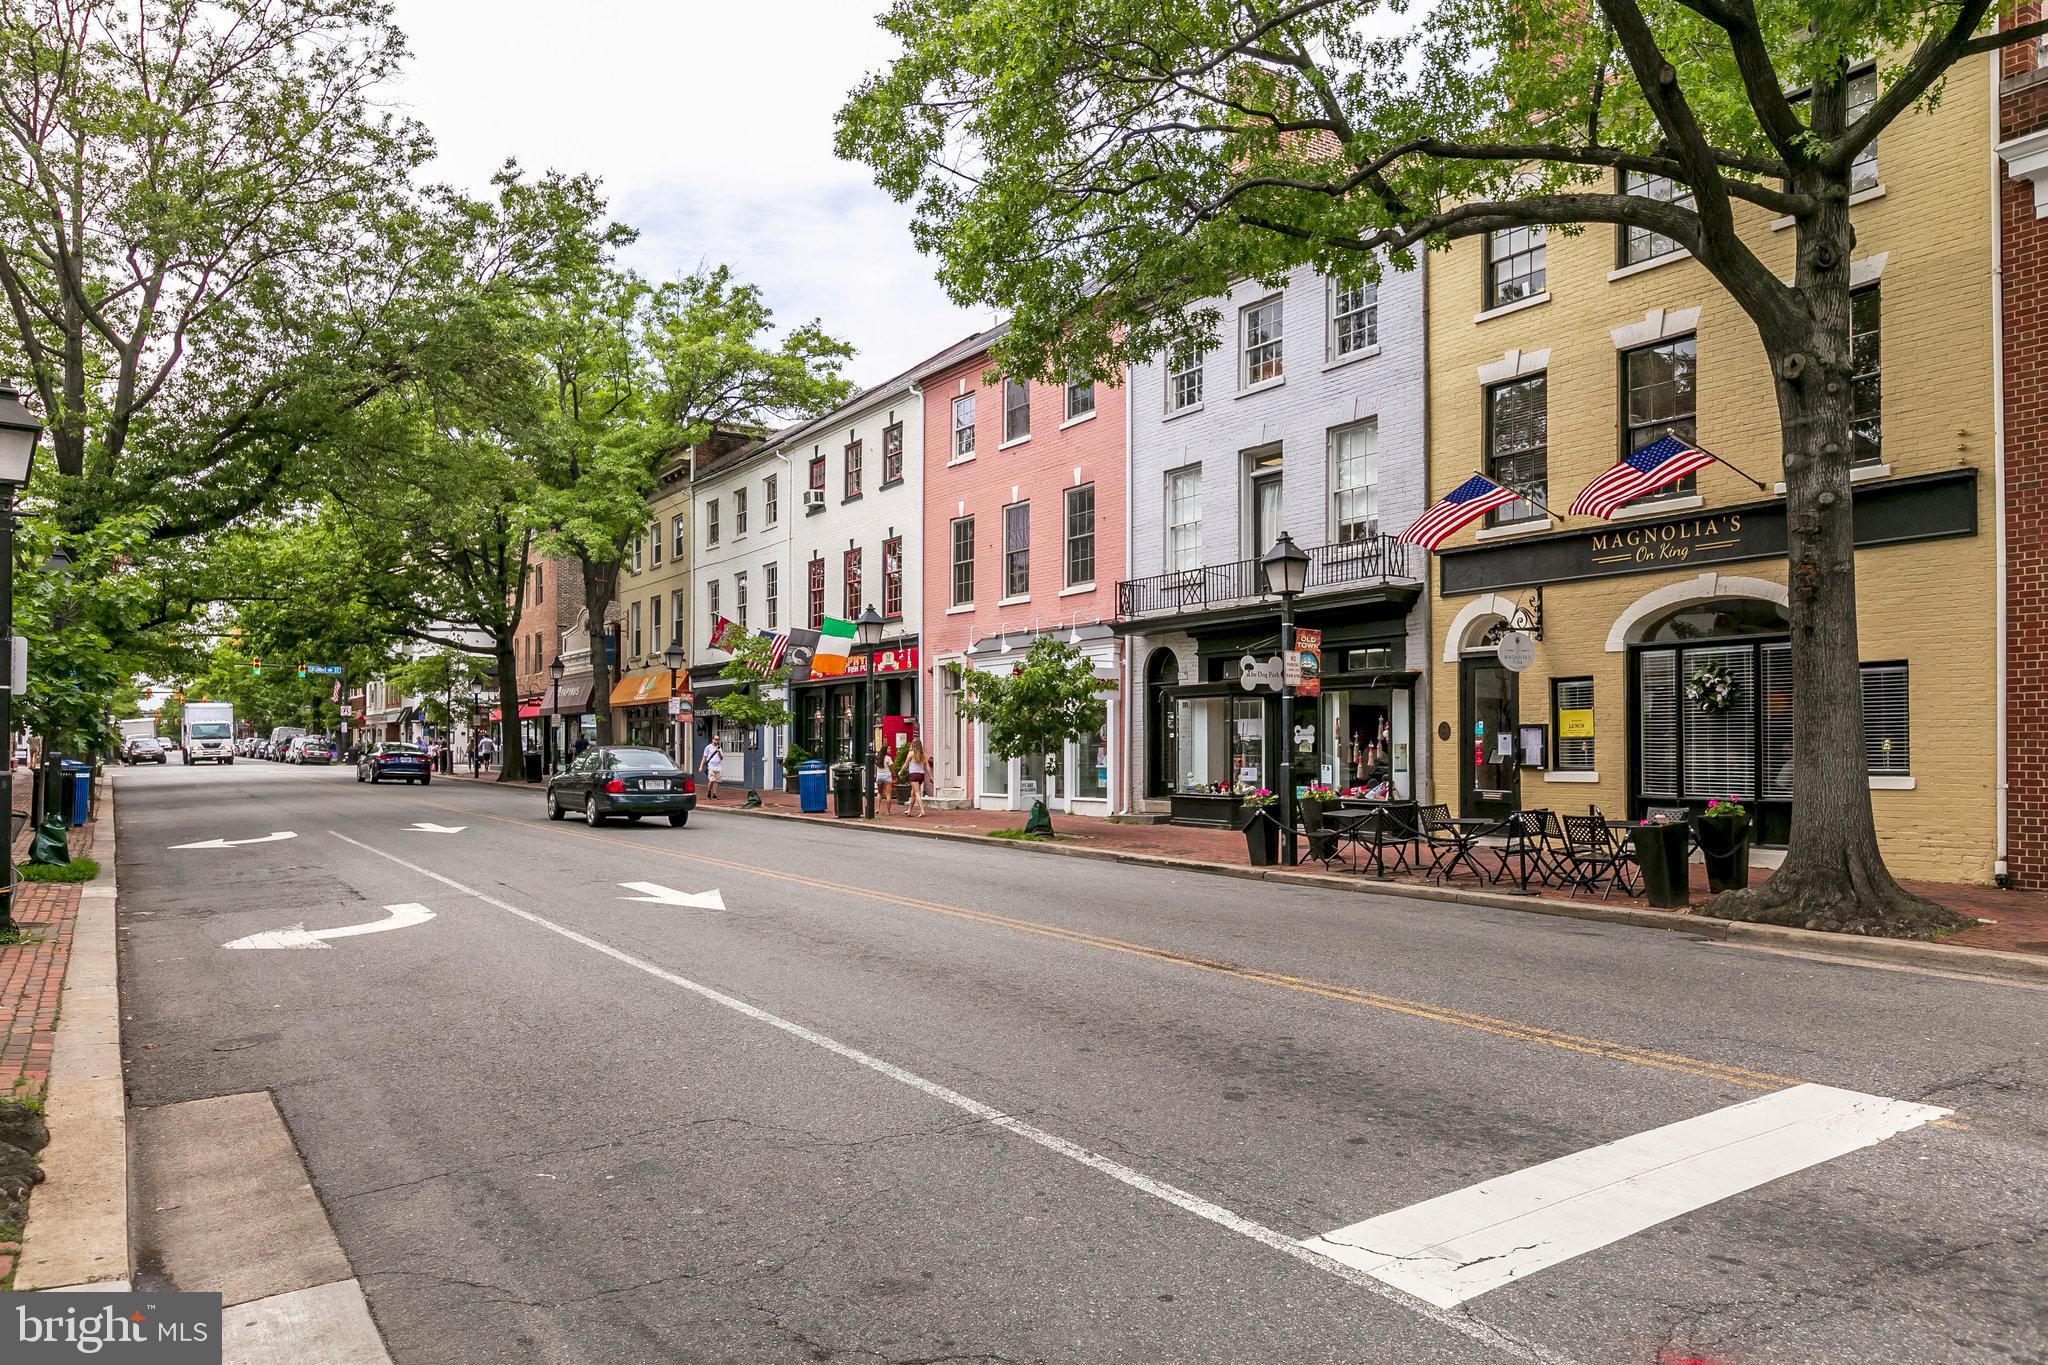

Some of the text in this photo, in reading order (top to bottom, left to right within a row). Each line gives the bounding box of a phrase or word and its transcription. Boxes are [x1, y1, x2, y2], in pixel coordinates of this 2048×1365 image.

[1592, 515, 1741, 551] MAGNOLIA'S
[1635, 542, 1690, 563] On King
[1300, 635, 1317, 643] OLD
[1297, 641, 1320, 649] TOWN
[1257, 671, 1268, 679] Dog
